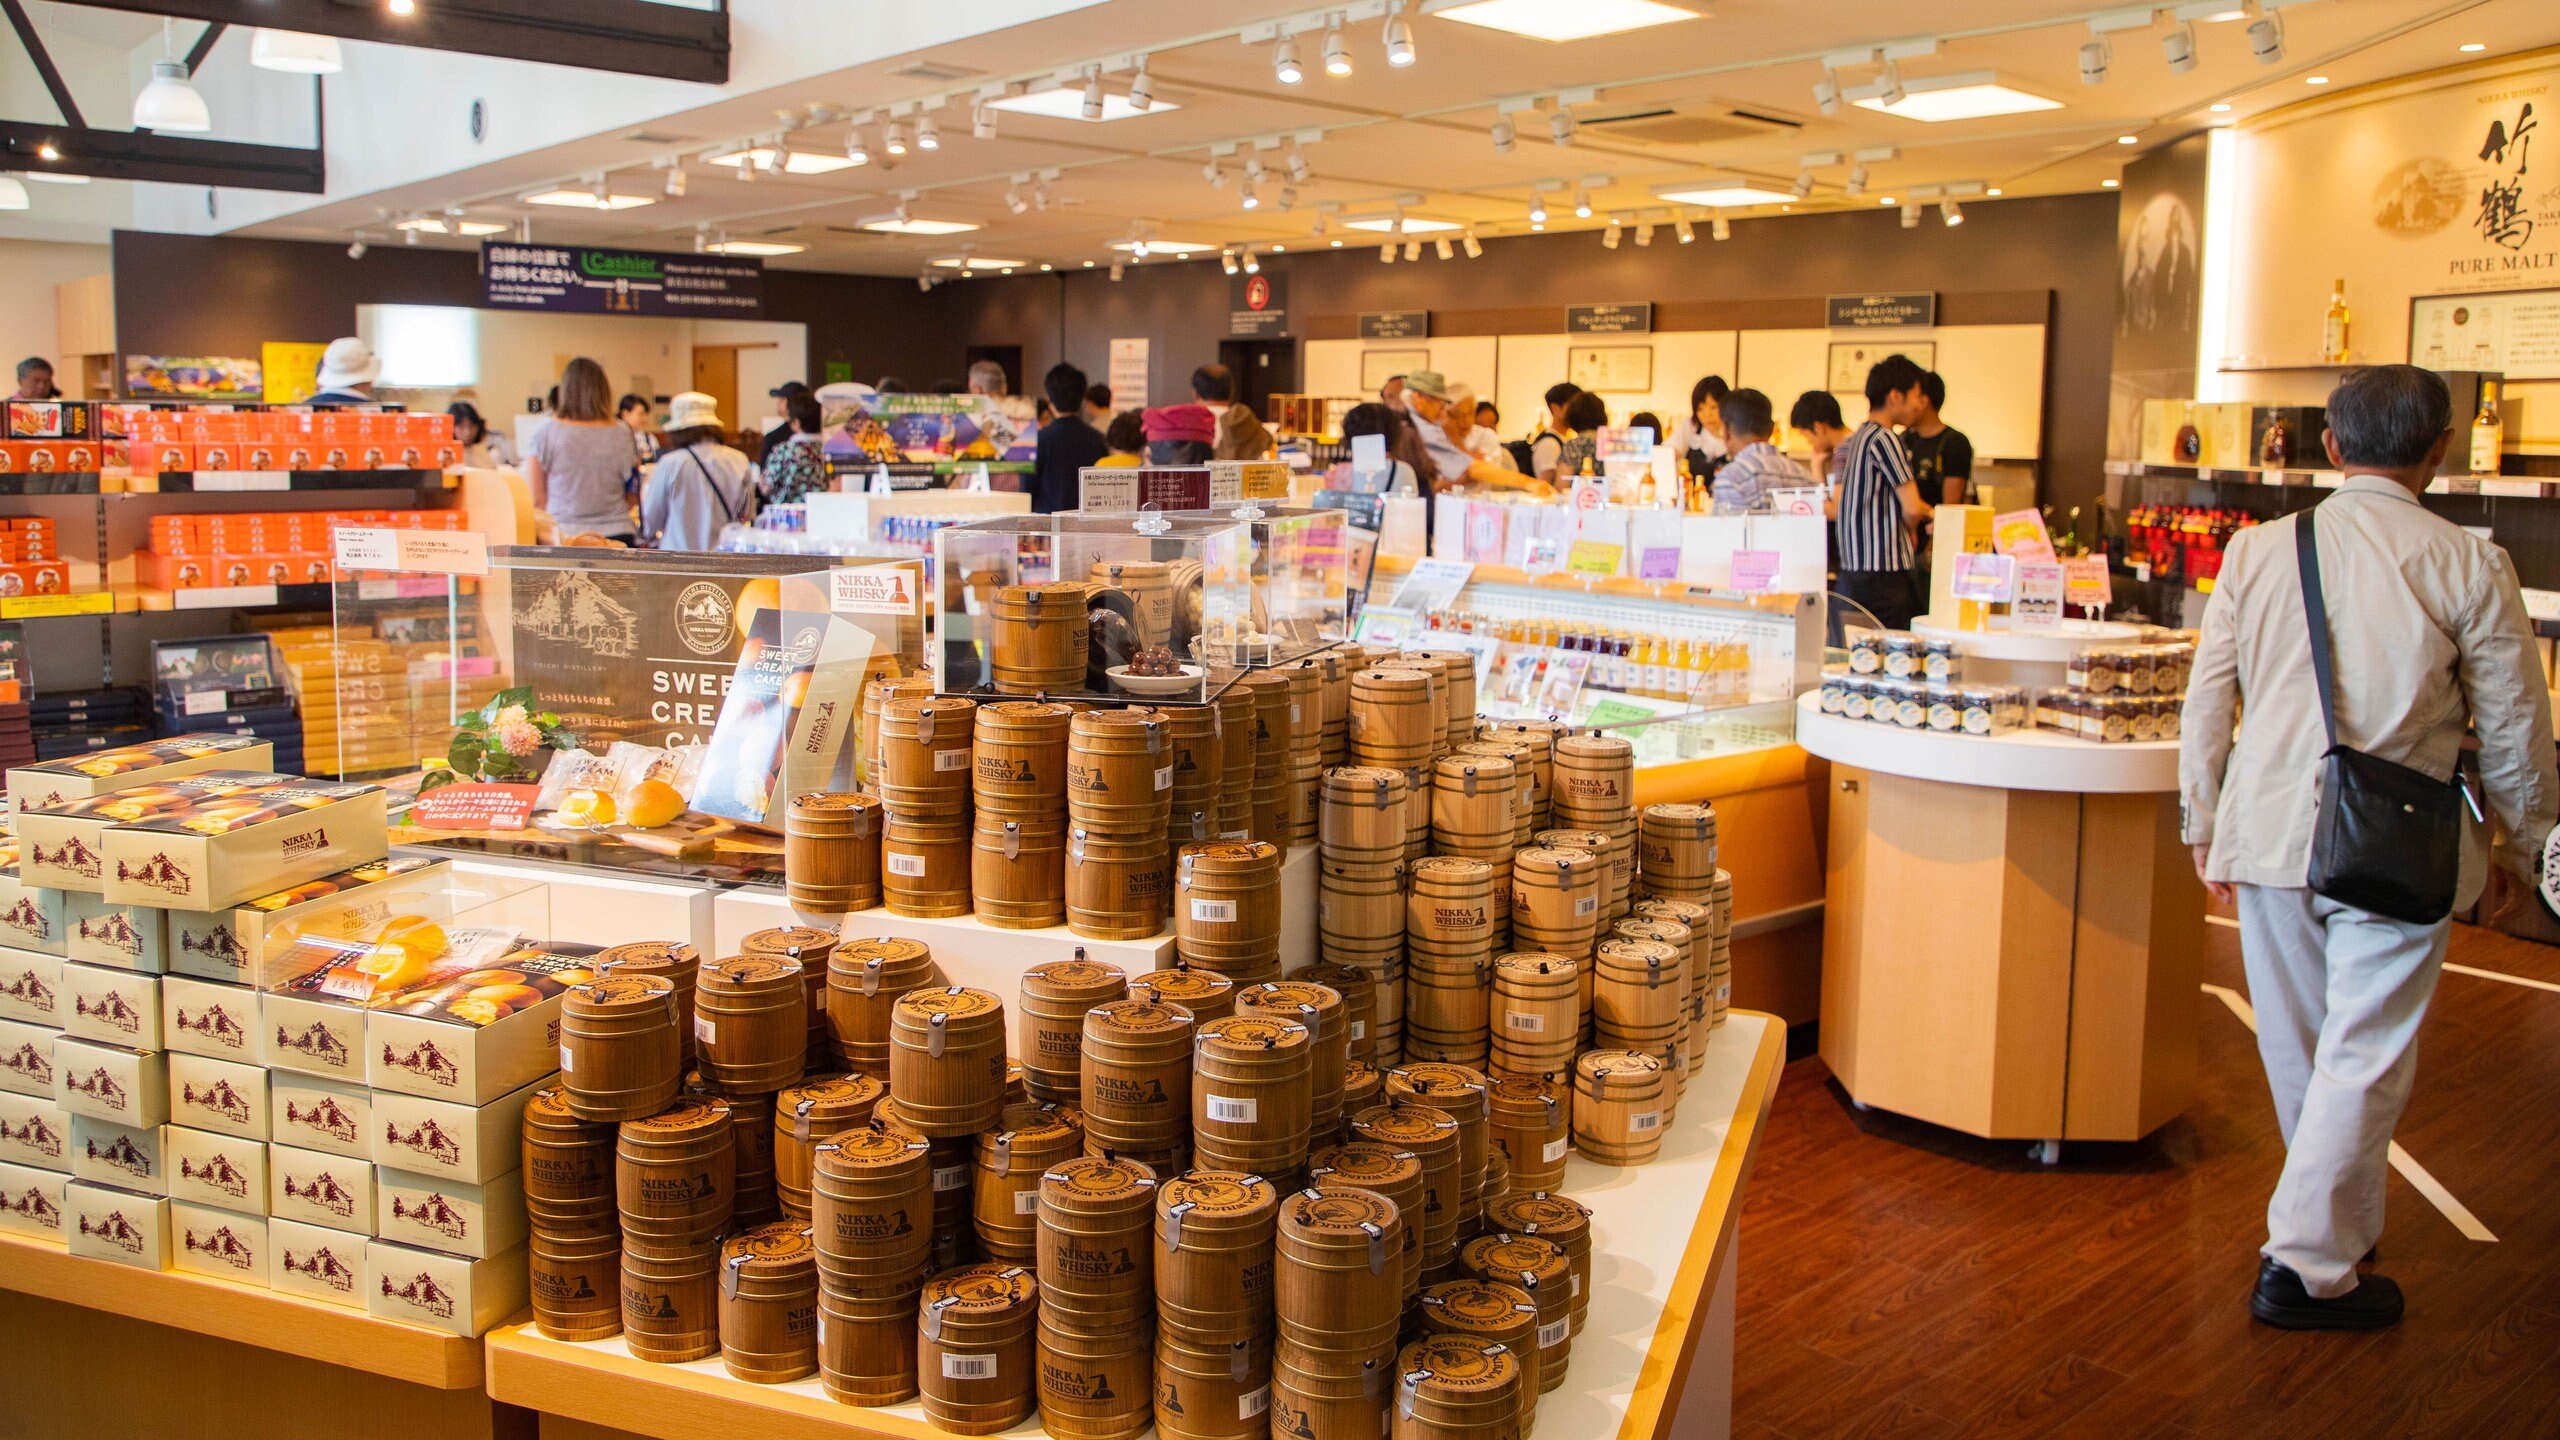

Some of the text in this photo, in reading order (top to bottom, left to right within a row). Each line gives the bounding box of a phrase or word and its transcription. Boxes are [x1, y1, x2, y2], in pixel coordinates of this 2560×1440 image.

[2474, 103, 2538, 250] 竹鶴
[590, 253, 657, 272] Cashier
[2450, 252, 2558, 275] PURE MALT
[490, 265, 584, 284] お待ちください。
[838, 574, 883, 588] NIKKA
[838, 587, 888, 600] WHISKY
[759, 650, 798, 662] SWEET
[563, 663, 607, 672] DISTILLERY
[754, 662, 794, 674] CREAM
[652, 670, 735, 696] SWEE
[755, 674, 783, 685] CAKE
[651, 701, 716, 725] CRE
[806, 717, 823, 752] NIKKA
[812, 715, 830, 754] WHISKY
[978, 756, 1012, 768] NIKKA
[978, 765, 1016, 779] WHISKY
[1569, 777, 1601, 787] NIKKA
[1569, 785, 1605, 795] WHISKY
[282, 833, 314, 848] NIKKA
[283, 839, 318, 858] WHISKY
[1129, 872, 1164, 884] NIKKA
[343, 904, 375, 919] NIKKA
[1435, 908, 1471, 917] NIKKA
[1435, 916, 1475, 926] WHISKY
[1095, 1075, 1140, 1091] NIKKA
[1096, 1086, 1146, 1102] WHISKY
[532, 1157, 574, 1170] NIKKA
[532, 1168, 577, 1182] WHISKY
[641, 1178, 690, 1189] NIKKA
[641, 1188, 695, 1201] WHISKY
[836, 1212, 887, 1225] NIKKA
[836, 1223, 893, 1237] WHISKY
[1057, 1247, 1107, 1261] NIKKA
[1057, 1258, 1114, 1273] WHISKY
[533, 1269, 567, 1286] NIKKA
[533, 1280, 572, 1297] WHISKY
[1043, 1362, 1085, 1384] NIKKA
[1044, 1374, 1090, 1397] WHISKY
